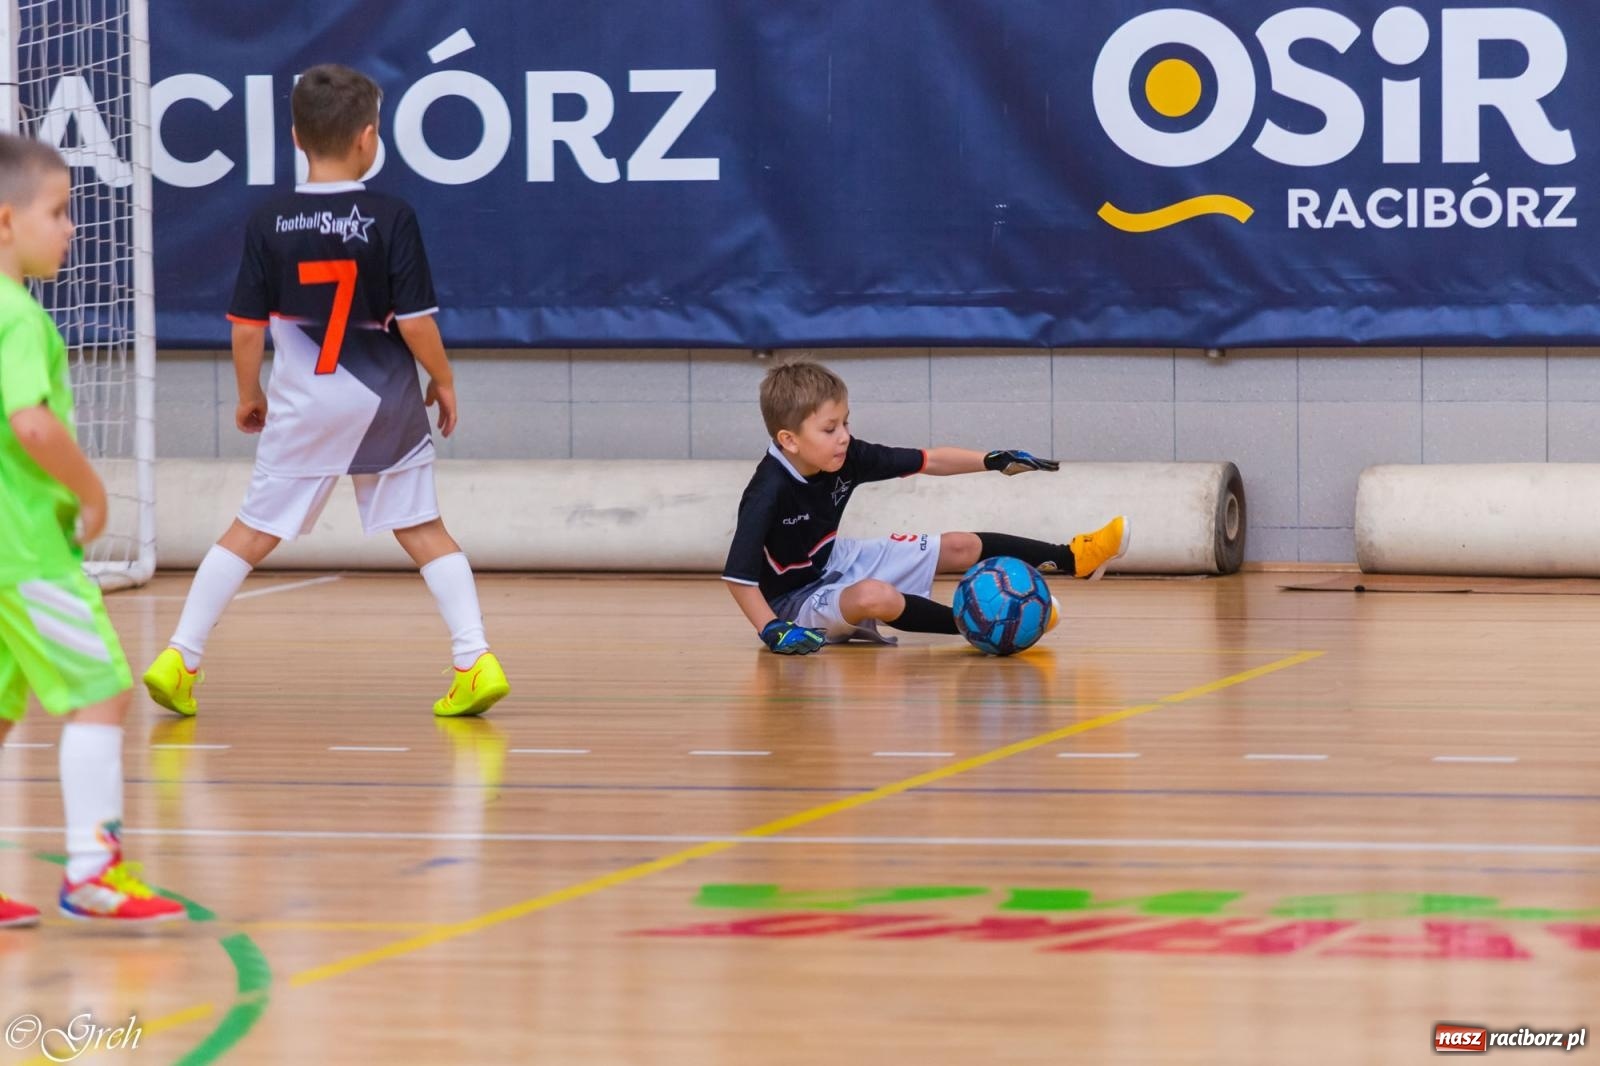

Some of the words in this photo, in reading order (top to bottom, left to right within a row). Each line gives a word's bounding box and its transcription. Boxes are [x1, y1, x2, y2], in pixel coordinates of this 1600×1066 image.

[37, 27, 720, 188] ACIÓRZ
[1287, 172, 1577, 229] RACIBÓRZ
[297, 259, 358, 375] 7
